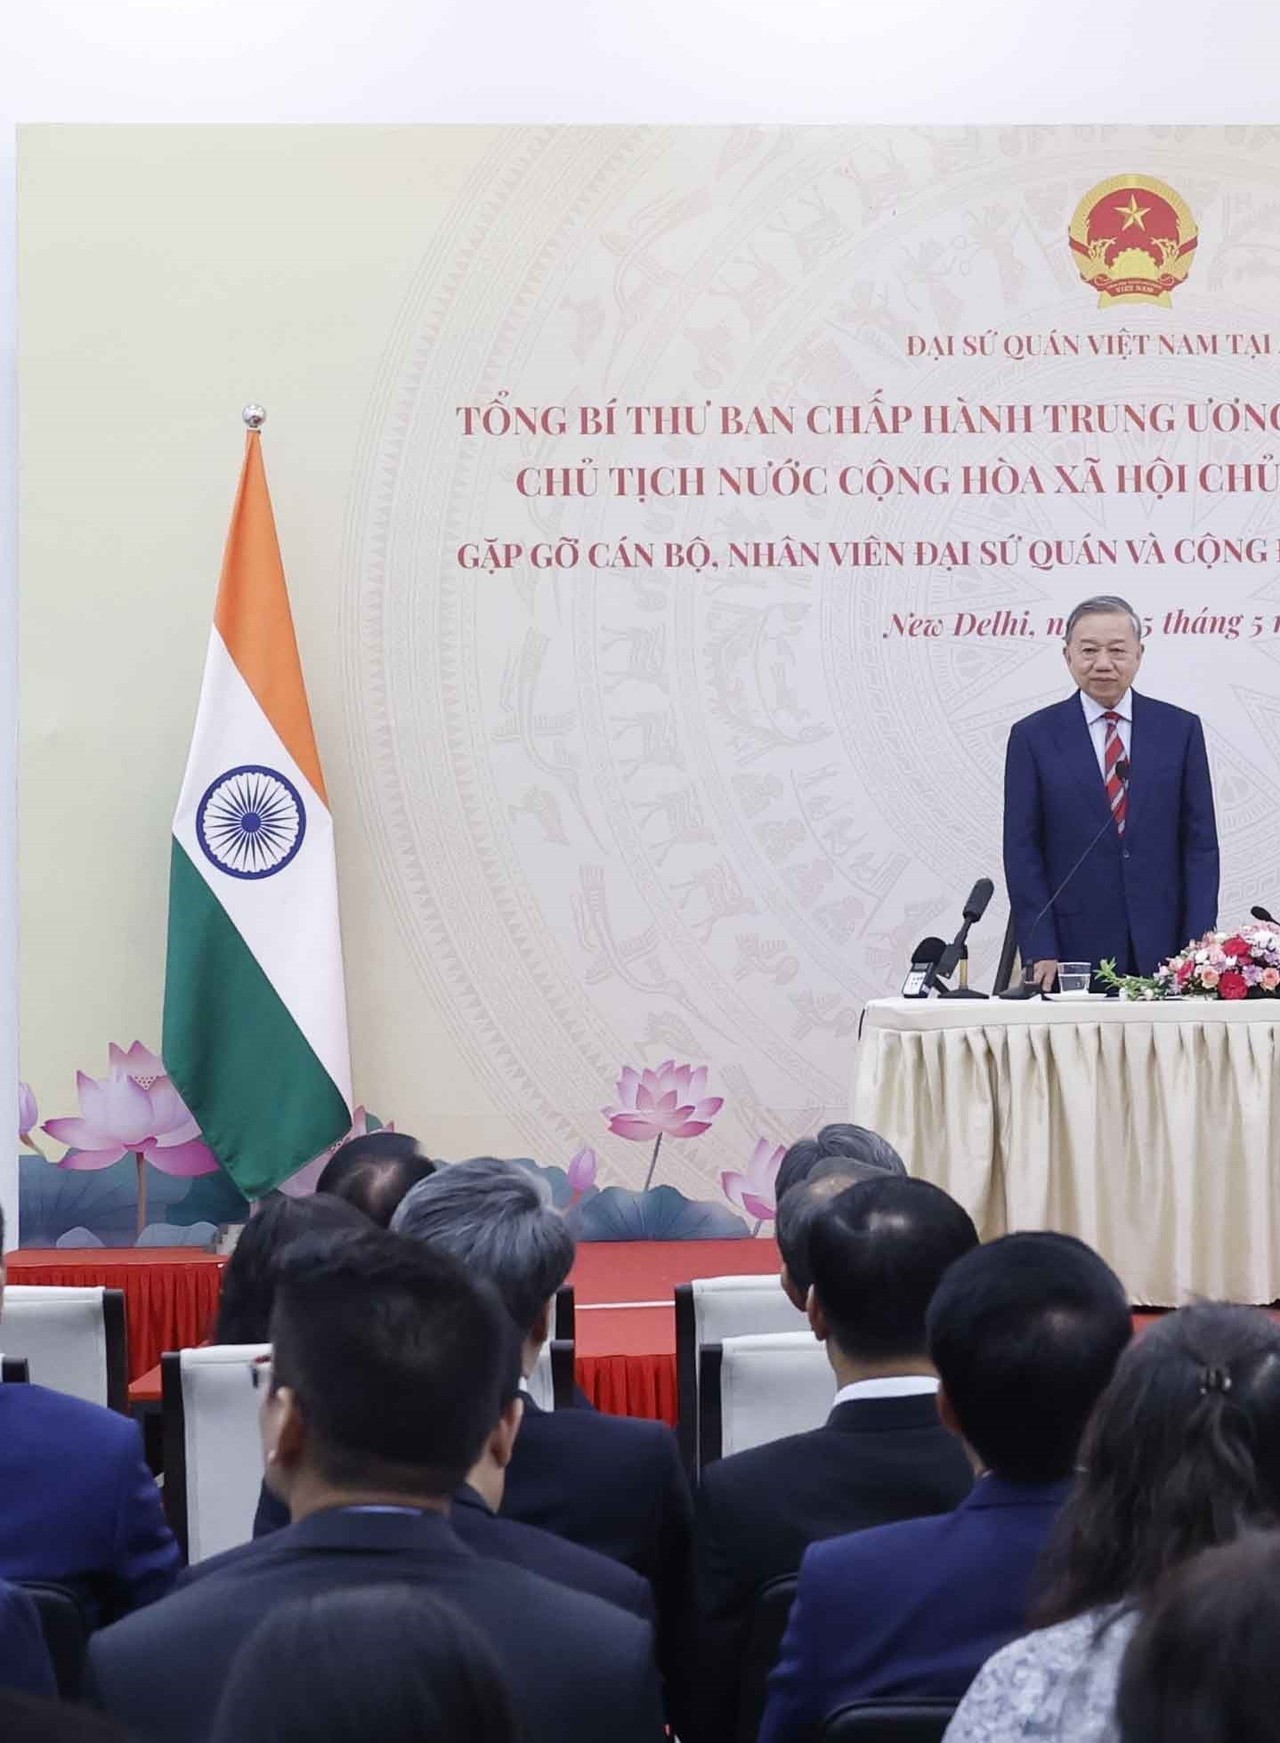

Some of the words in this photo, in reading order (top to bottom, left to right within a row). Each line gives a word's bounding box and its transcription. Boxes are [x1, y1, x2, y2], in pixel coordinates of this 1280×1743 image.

[963, 329, 998, 356] SỨ
[1004, 329, 1079, 360] QUÁN
[1088, 327, 1150, 360] VIỆT
[1158, 334, 1218, 355] NAM
[1226, 334, 1270, 359] TẠI
[456, 389, 566, 436] TỔNG
[579, 397, 616, 435] BÍ
[626, 400, 711, 435] THƯ
[720, 405, 795, 435] BAN
[806, 388, 912, 435] CHẤP
[923, 396, 1033, 434] HÀNH
[1043, 404, 1175, 434] TRUNG
[516, 456, 598, 497] CHỦ
[609, 466, 705, 503] TỊCH
[717, 459, 828, 496] NƯỚC
[839, 457, 949, 501] CỘNG
[960, 457, 1041, 494] HÒA
[1055, 455, 1106, 494] XÃ
[1116, 456, 1187, 500] HỘI
[1198, 453, 1280, 492] CHỦ
[457, 537, 523, 573] GẶP
[529, 536, 580, 569] GỠ
[588, 534, 654, 568] CÁN
[664, 536, 717, 573] BỘ,
[728, 534, 820, 567] NHÂN
[827, 534, 904, 567] VIÊN
[913, 541, 971, 573] ĐẠI
[979, 531, 1023, 567] SỨ
[1028, 533, 1118, 570] QUÁN
[1124, 533, 1166, 565] VÀ
[1174, 531, 1267, 570] CỘNG
[883, 612, 944, 639] New
[952, 611, 1036, 638] Delhi,
[1163, 609, 1243, 639] tháng
[1251, 614, 1264, 638] 5
